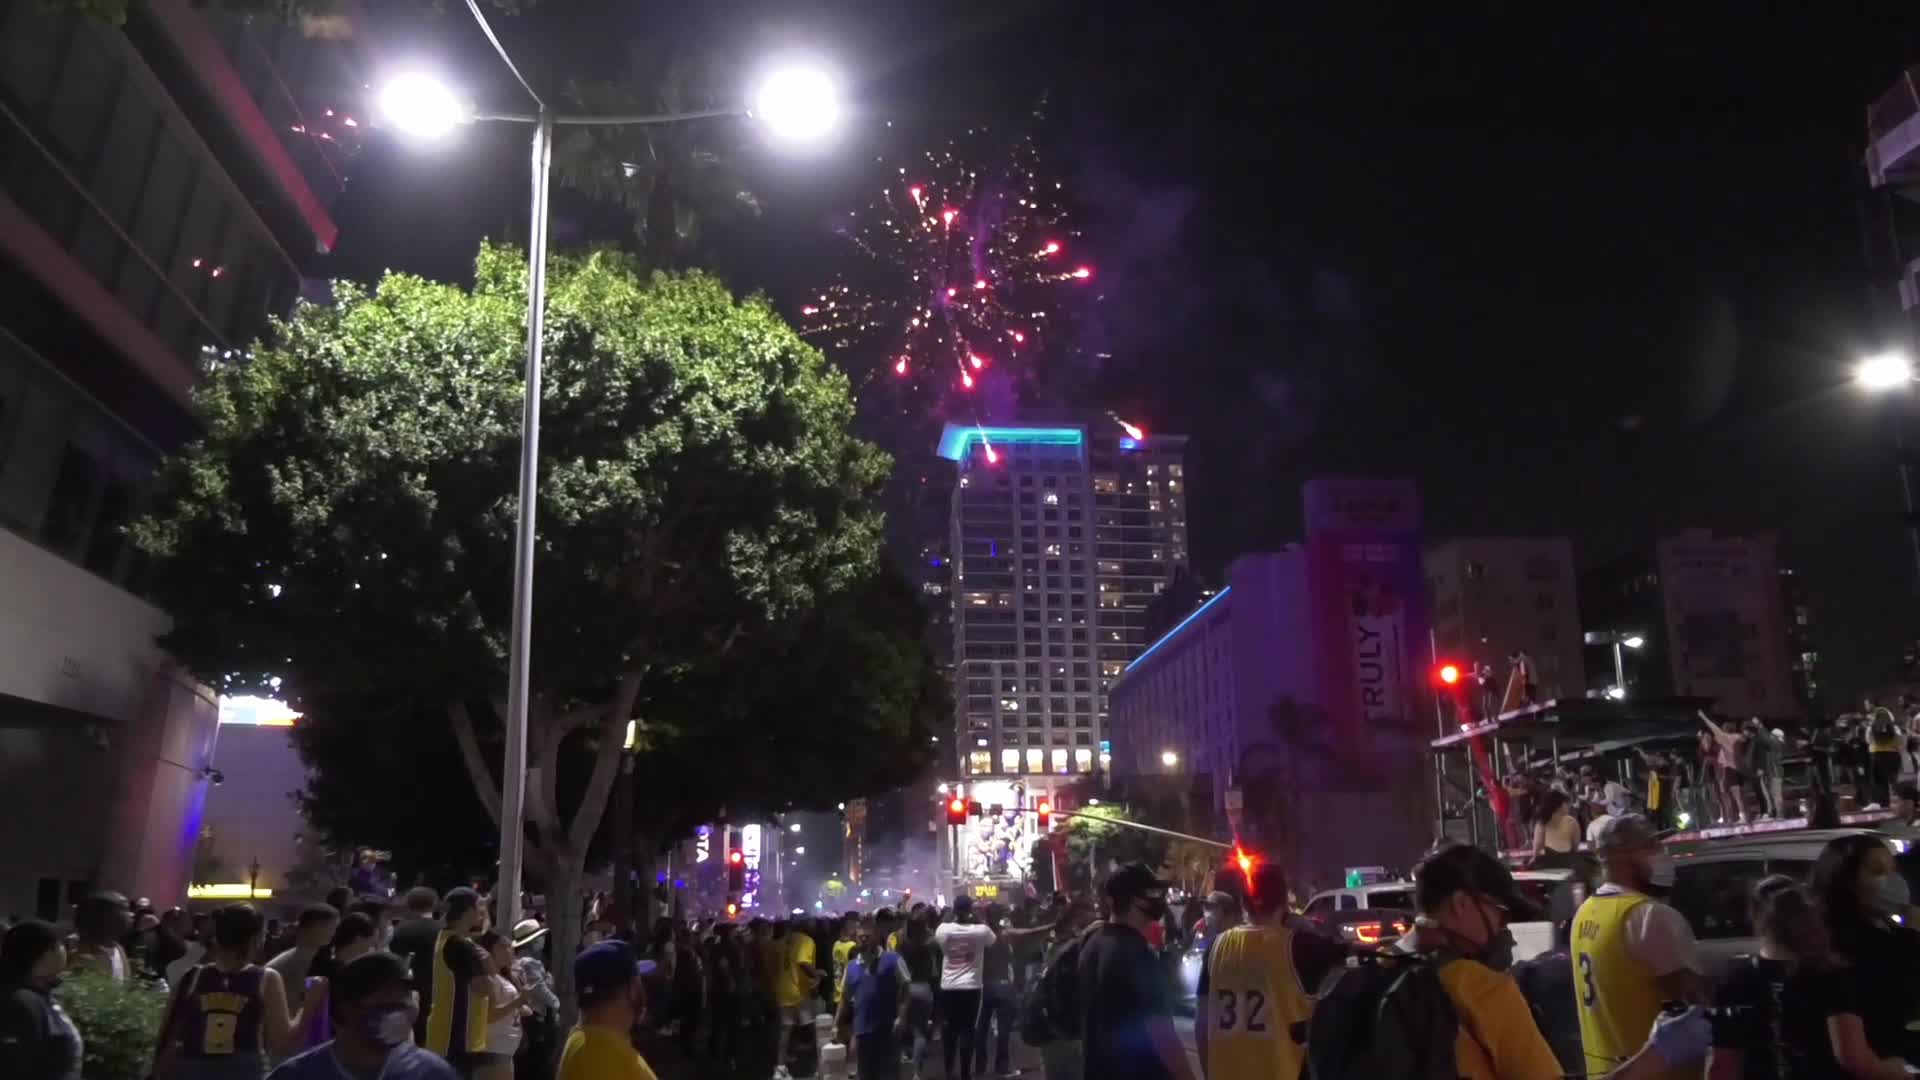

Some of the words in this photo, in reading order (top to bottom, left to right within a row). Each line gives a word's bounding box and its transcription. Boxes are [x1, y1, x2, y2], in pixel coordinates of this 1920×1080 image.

[1359, 626, 1384, 722] TRULY
[1579, 951, 1594, 1008] 3
[1219, 989, 1266, 1031] 32
